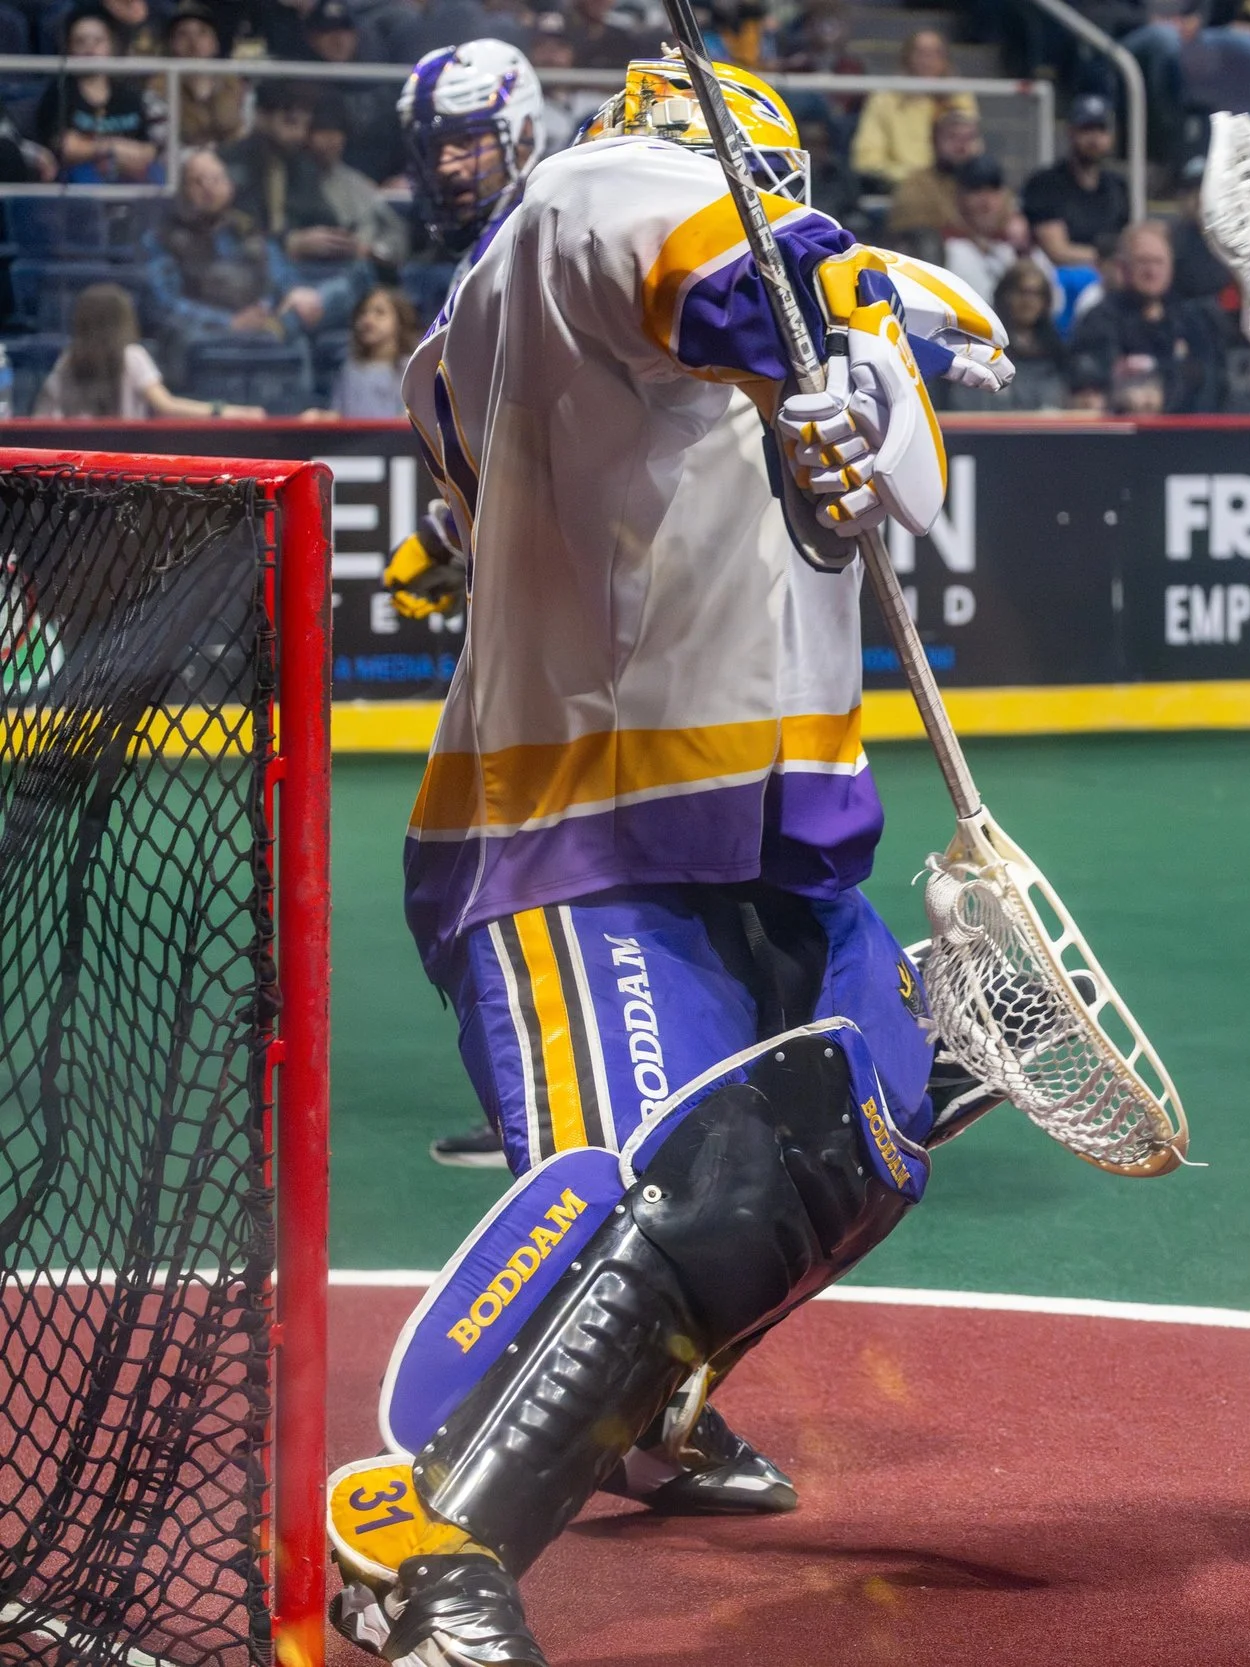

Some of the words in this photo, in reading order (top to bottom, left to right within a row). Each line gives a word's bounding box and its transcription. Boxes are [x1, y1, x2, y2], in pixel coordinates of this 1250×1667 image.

[860, 1095, 911, 1189] BODDAM
[446, 1187, 588, 1354] BODDAM
[349, 1480, 415, 1535] 31
